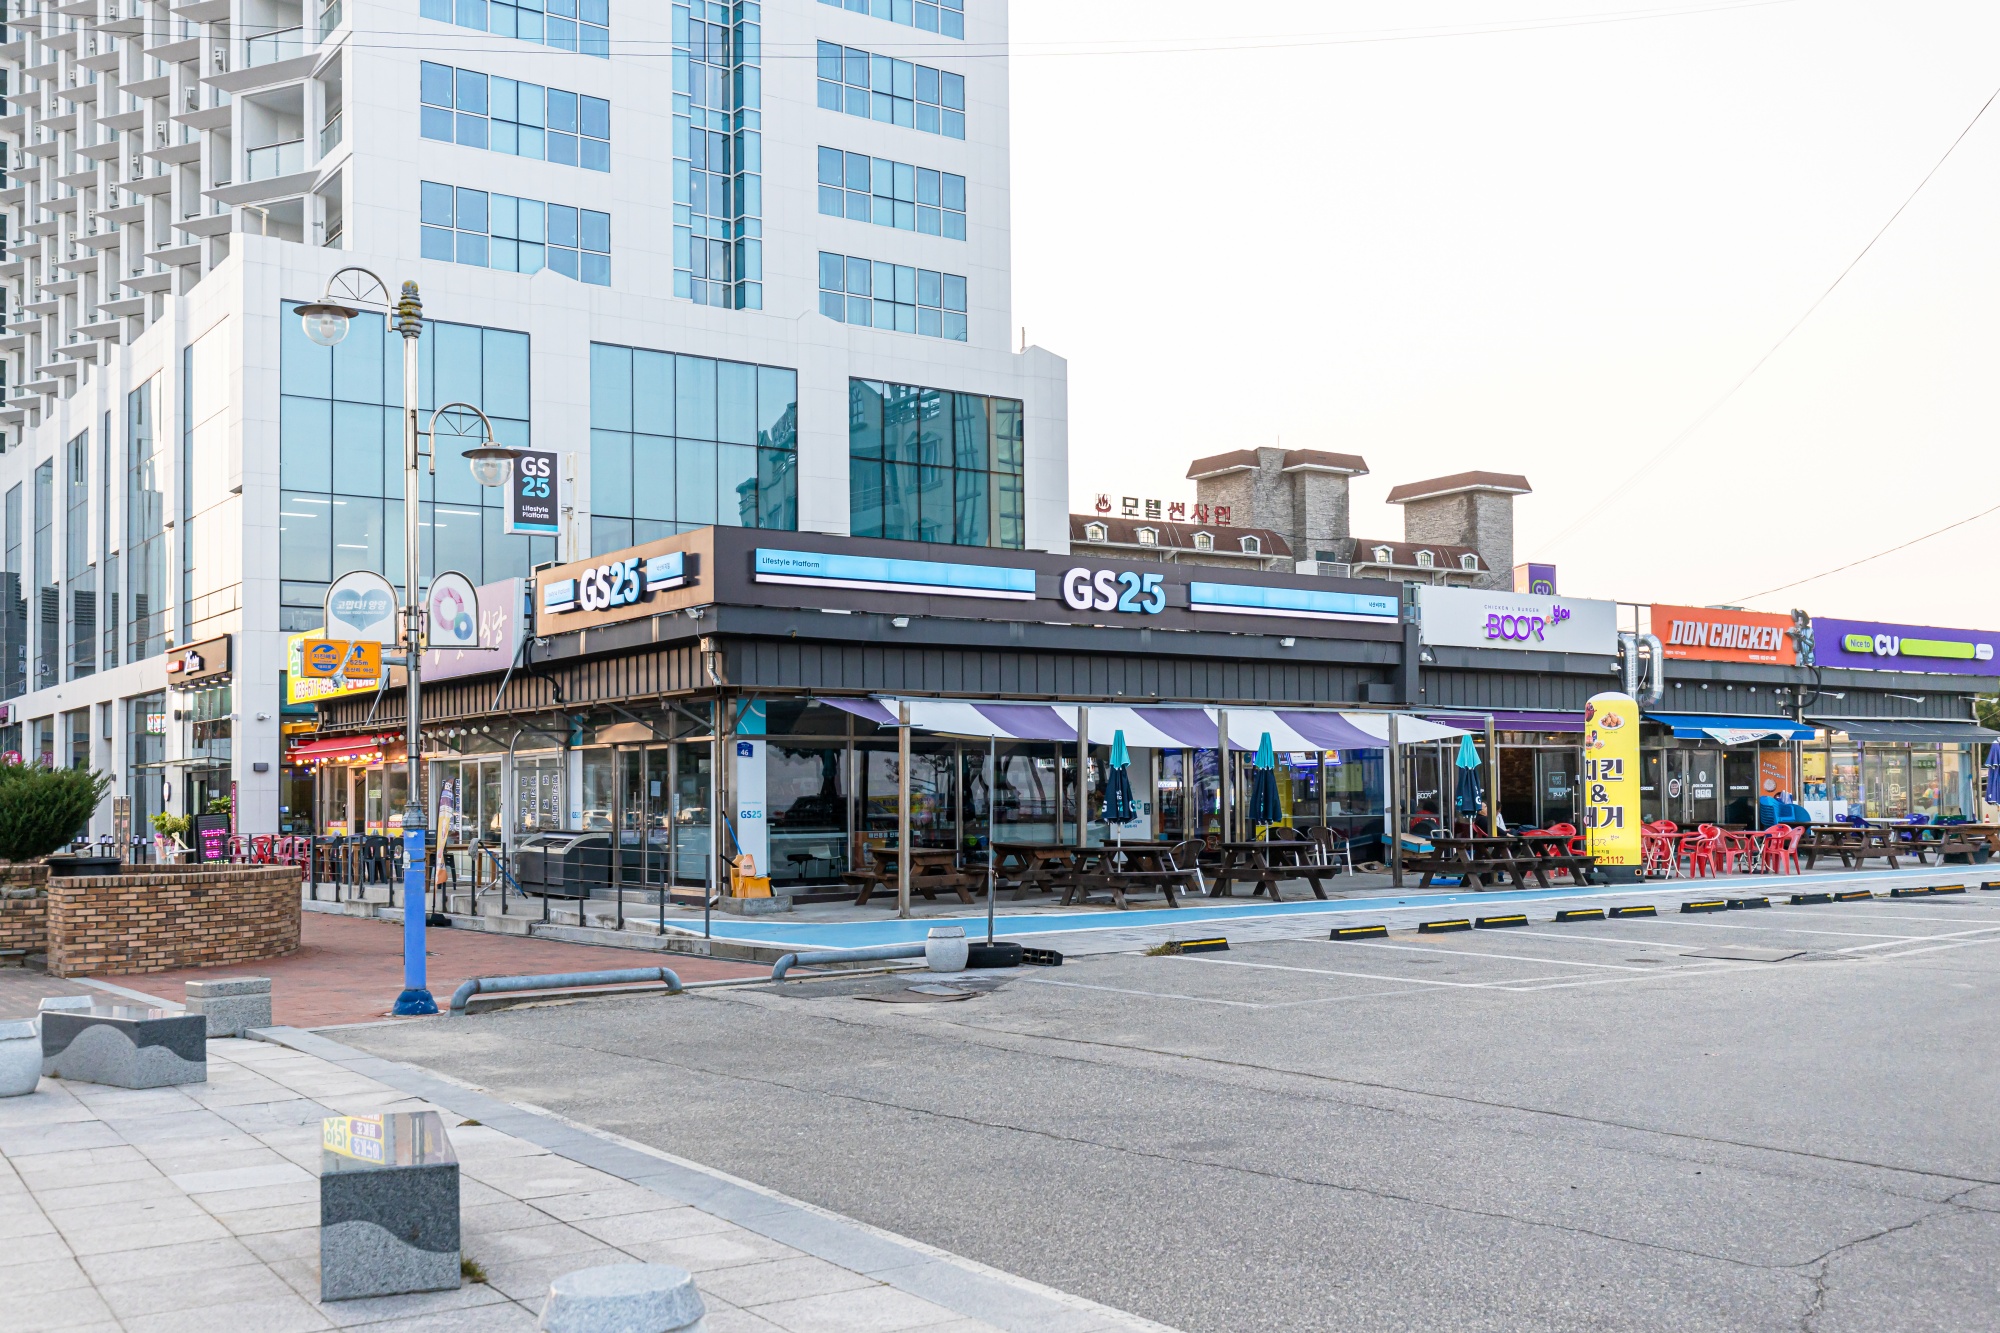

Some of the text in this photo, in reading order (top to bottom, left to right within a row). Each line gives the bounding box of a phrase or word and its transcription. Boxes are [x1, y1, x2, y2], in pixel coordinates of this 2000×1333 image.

[520, 456, 550, 477] GS
[521, 476, 550, 498] 25
[522, 504, 549, 513] Lifestyle
[522, 511, 549, 519] Platform
[762, 556, 820, 569] Lifestyle Platform
[579, 557, 643, 612] GS25
[1063, 567, 1166, 614] GS25
[1535, 585, 1549, 595] CU
[336, 600, 387, 610] 고맙다! 양양
[1552, 604, 1571, 625] 부어
[479, 605, 508, 647] 식당
[1485, 613, 1545, 642] BOOR
[1669, 620, 1784, 651] DON CHICKEN
[1850, 633, 1900, 657] Nice to CU
[1591, 784, 1609, 803] &
[740, 810, 762, 819] GS25
